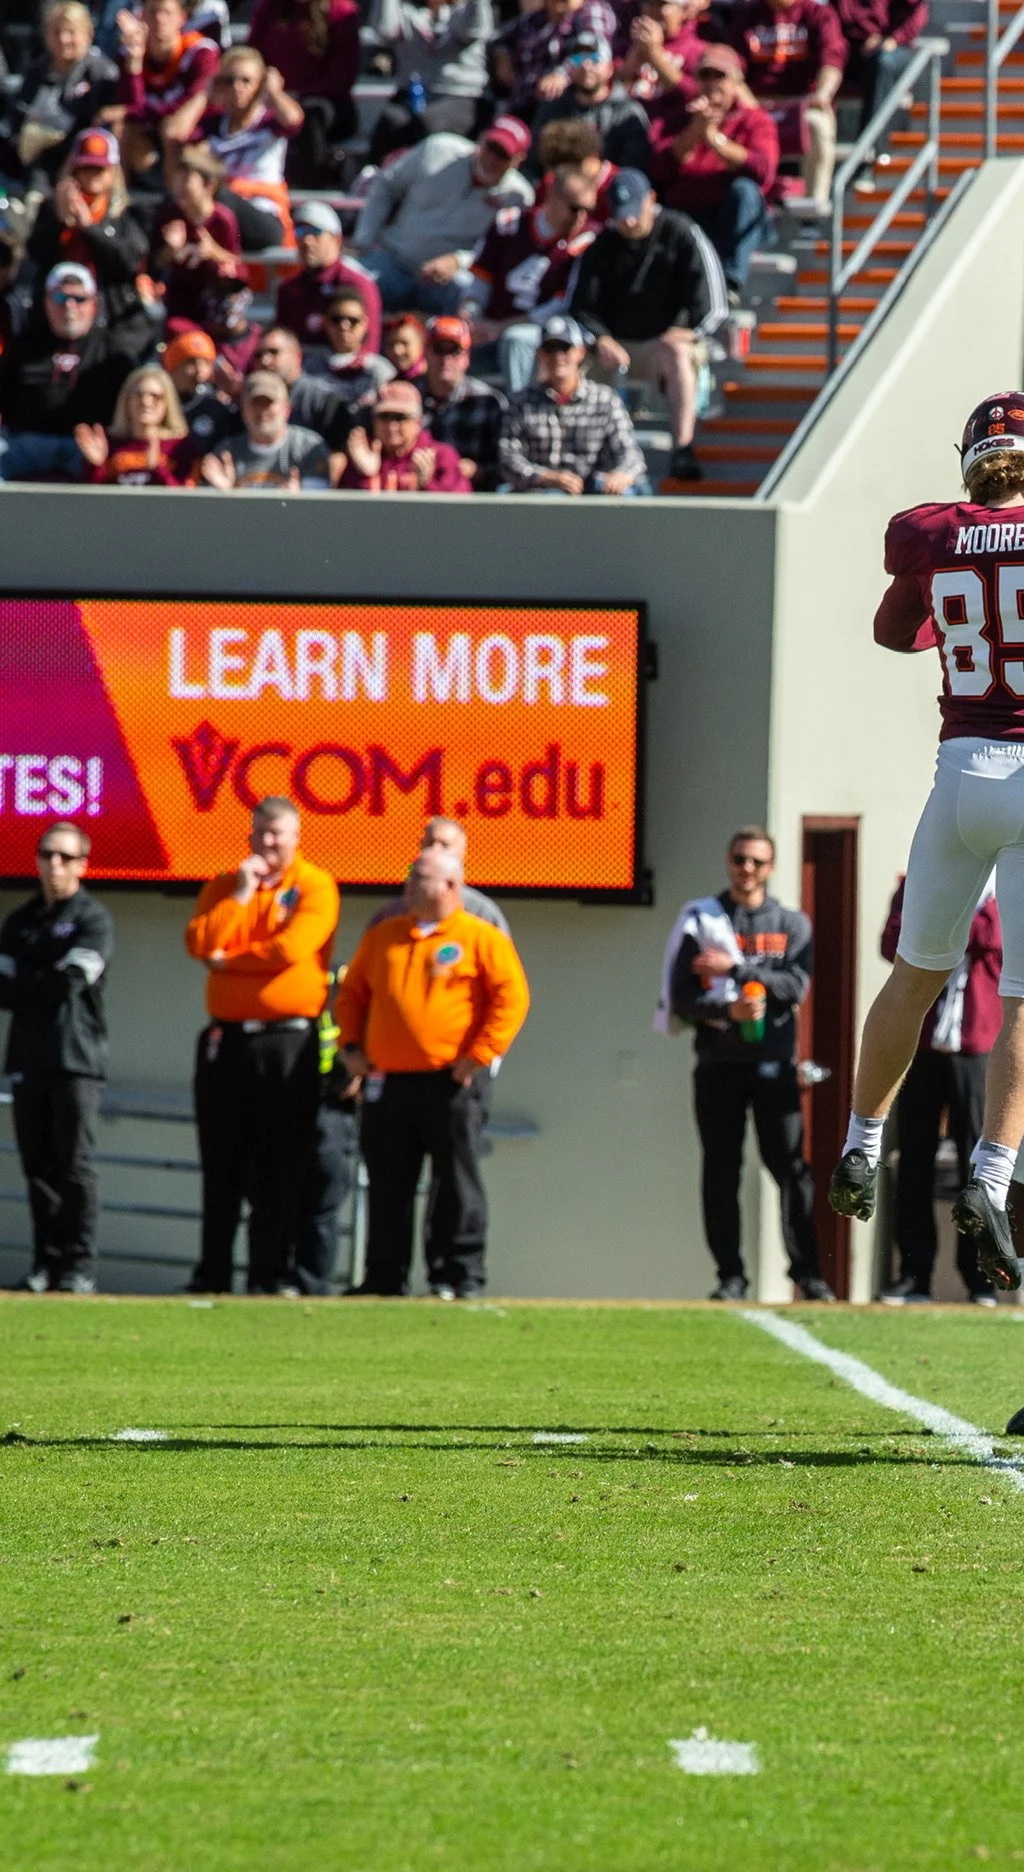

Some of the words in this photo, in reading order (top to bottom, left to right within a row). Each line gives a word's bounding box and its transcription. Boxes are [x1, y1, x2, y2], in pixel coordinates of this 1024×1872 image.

[168, 626, 388, 701] LEARN
[412, 631, 609, 707] MORE
[171, 719, 605, 819] VCOM.edu
